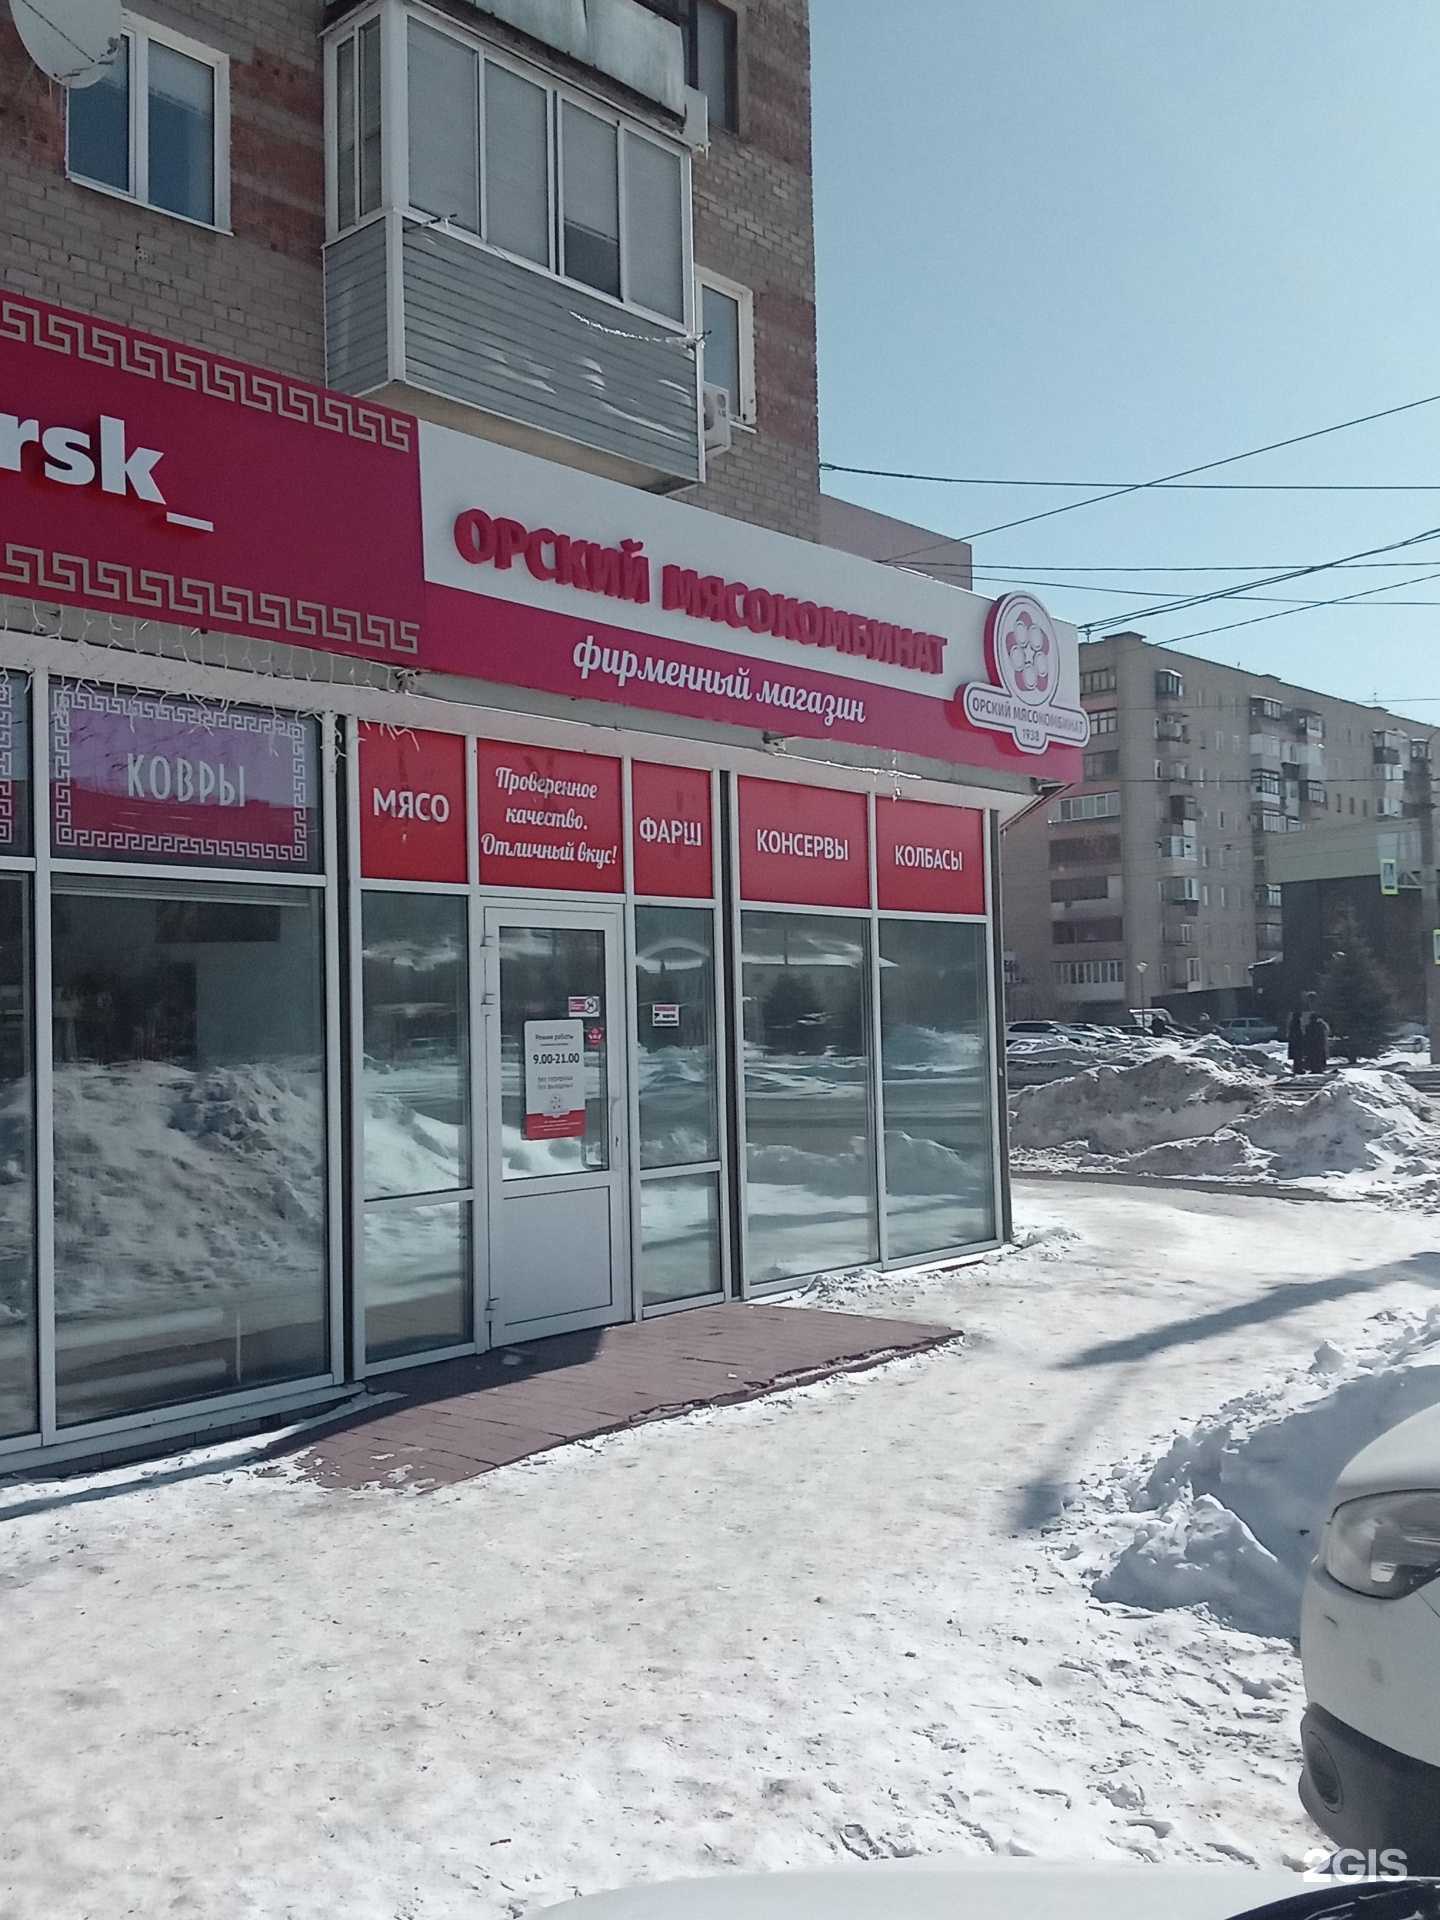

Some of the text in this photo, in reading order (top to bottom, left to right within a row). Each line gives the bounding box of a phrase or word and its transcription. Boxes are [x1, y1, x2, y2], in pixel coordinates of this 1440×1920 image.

[453, 509, 948, 673] ОРСКИЙ МЯСОКОМБИНАТ
[573, 635, 866, 726] фирменный магазин
[972, 697, 1012, 718] ОРСКИЙ
[127, 753, 245, 807] КОВРЫ
[495, 766, 598, 799] Проверенное
[373, 787, 450, 823] МЯСО
[505, 807, 588, 830] качество.
[639, 817, 702, 847] ФАРШ
[756, 829, 849, 861] КОНСЕРВЫ
[481, 833, 618, 870] Отличный вкус!
[895, 845, 963, 871] КОЛБАСЫ
[533, 1053, 580, 1065] 9.00-21.00
